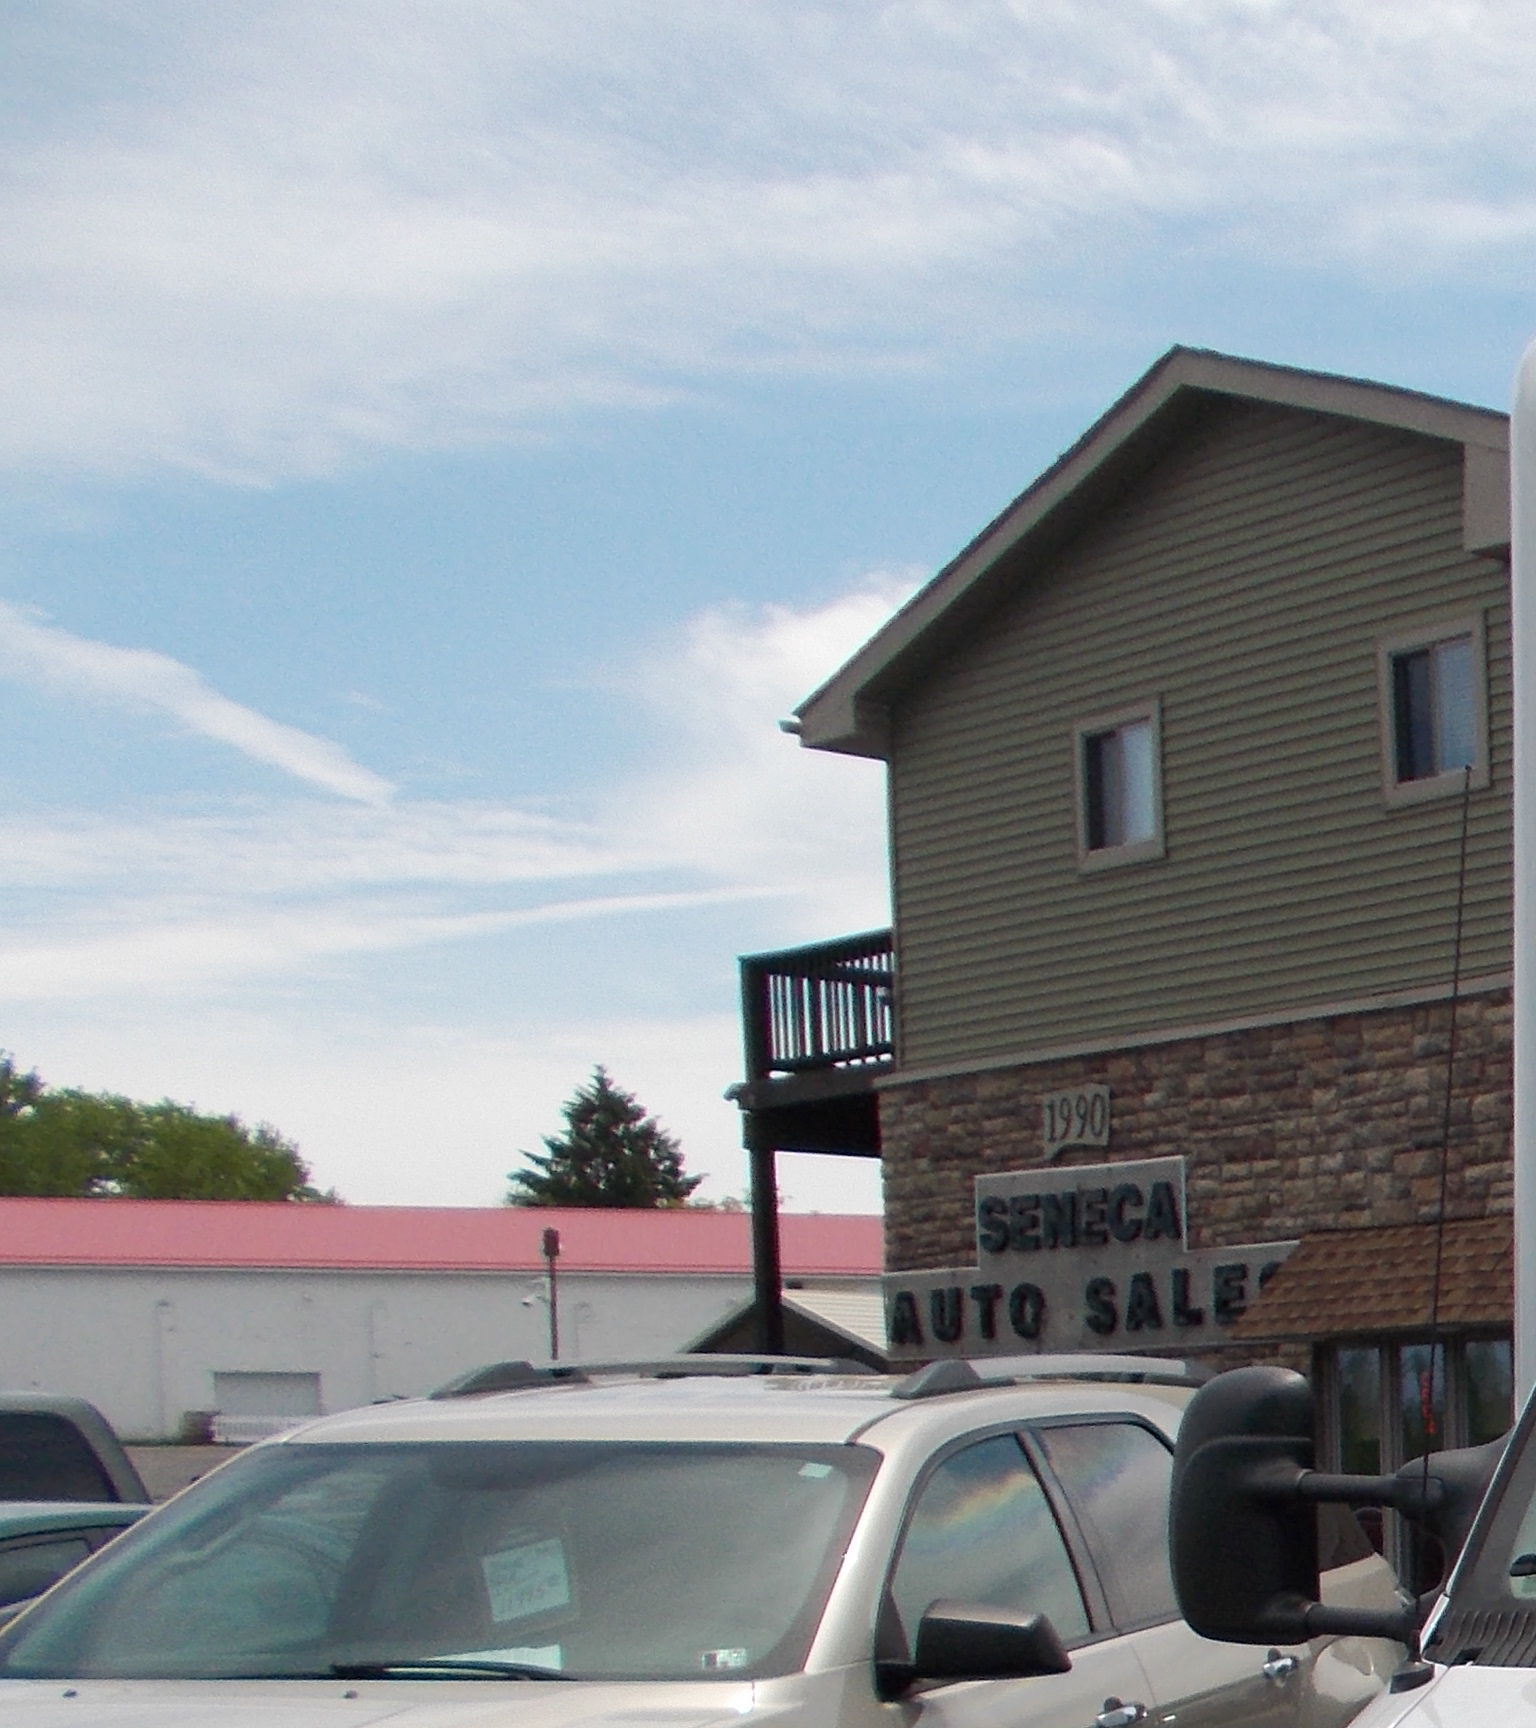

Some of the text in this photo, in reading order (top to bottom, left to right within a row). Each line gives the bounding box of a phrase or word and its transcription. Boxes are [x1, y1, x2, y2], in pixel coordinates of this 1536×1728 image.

[1046, 1094, 1107, 1143] 1990
[978, 1181, 1182, 1254] SENECA
[890, 1261, 1283, 1346] AUTO SALE
